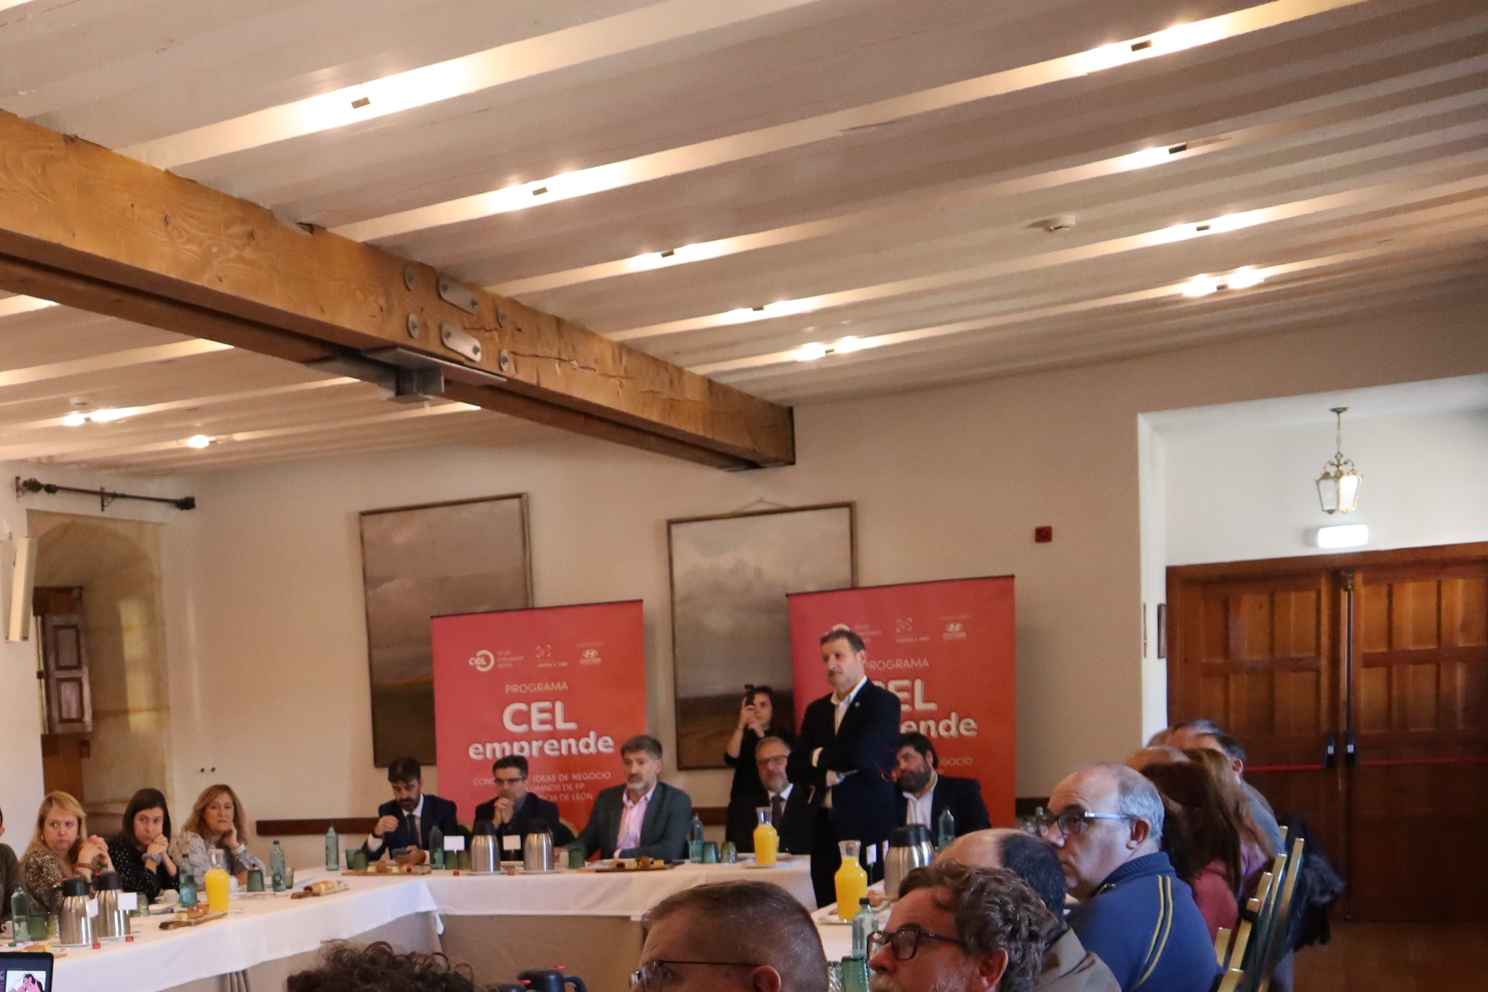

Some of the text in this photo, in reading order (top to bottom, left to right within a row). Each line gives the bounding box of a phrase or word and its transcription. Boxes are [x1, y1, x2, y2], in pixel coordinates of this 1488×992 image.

[505, 681, 569, 694] PROGRAMA
[872, 679, 939, 711] EL
[503, 700, 577, 733] CEL
[468, 730, 615, 760] emprende
[533, 773, 557, 783] IDEAS
[558, 773, 570, 782] DE
[571, 771, 612, 781] NEGOCIO
[562, 783, 573, 791] DE
